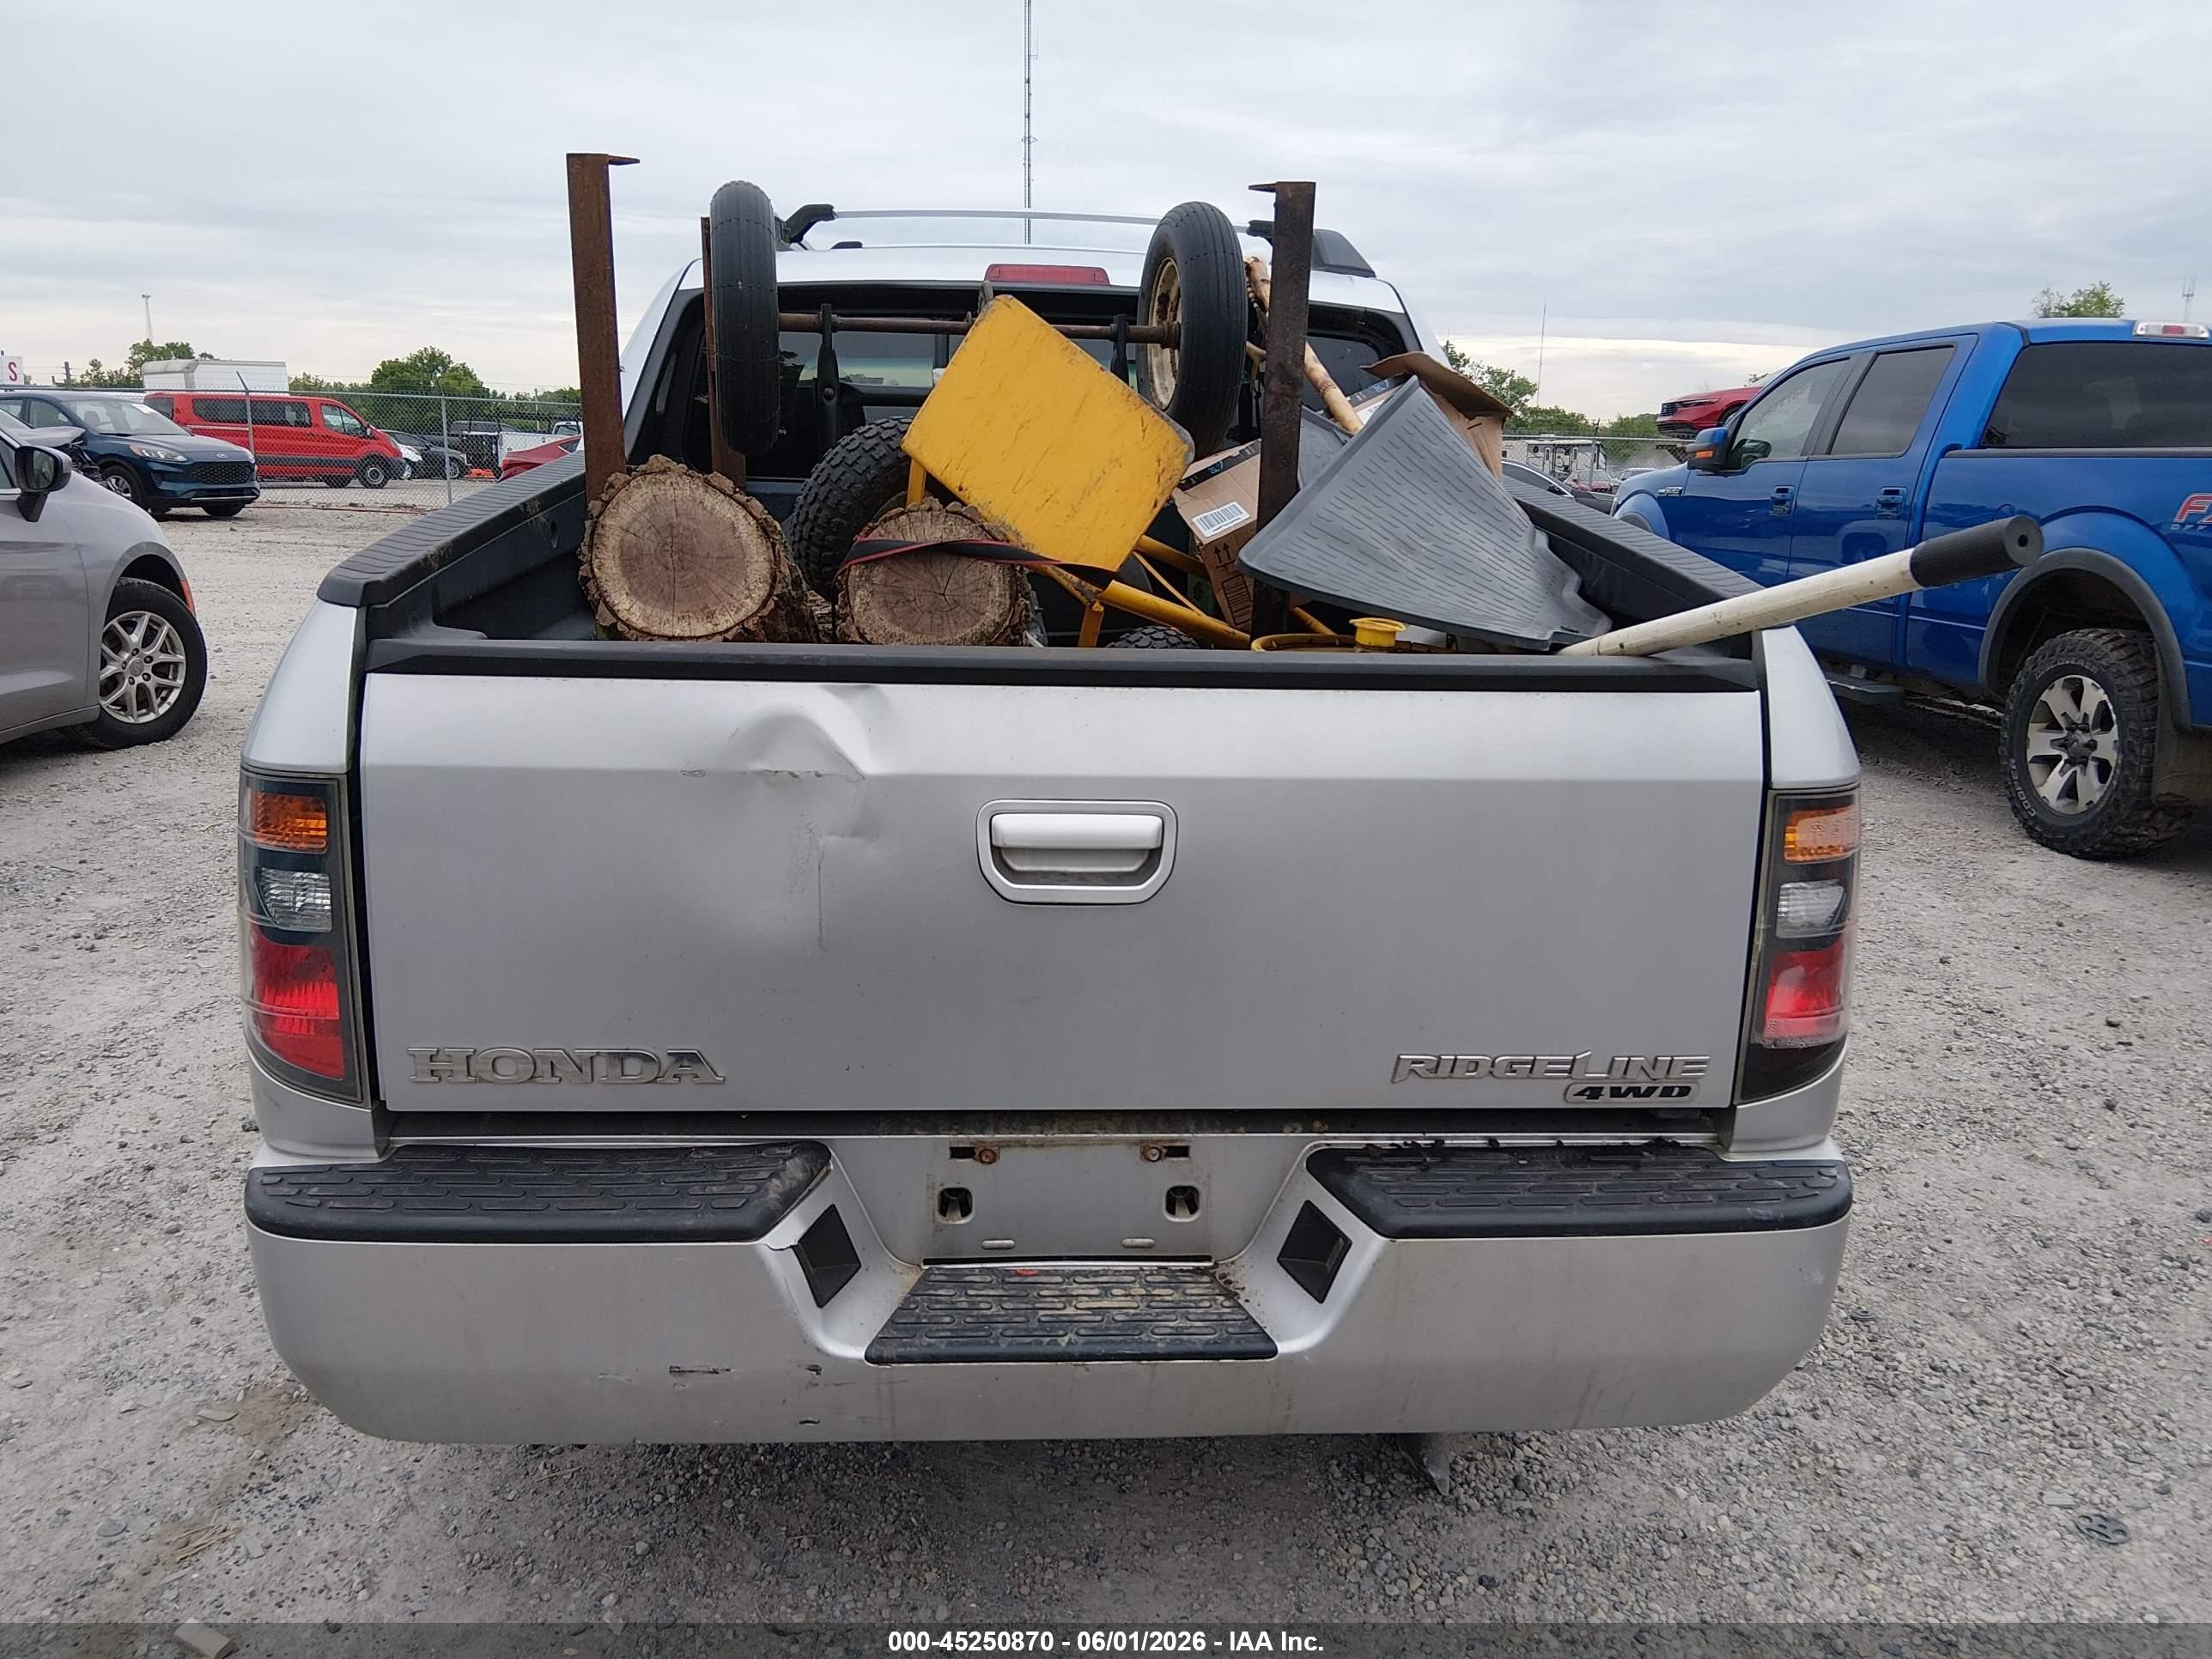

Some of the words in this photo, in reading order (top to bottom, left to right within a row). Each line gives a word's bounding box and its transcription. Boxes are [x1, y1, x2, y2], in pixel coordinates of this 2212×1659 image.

[9, 362, 17, 381] S
[407, 1047, 726, 1085] HONDA
[1391, 1050, 1711, 1084] RIDGELINE
[1572, 1085, 1692, 1101] 4WD
